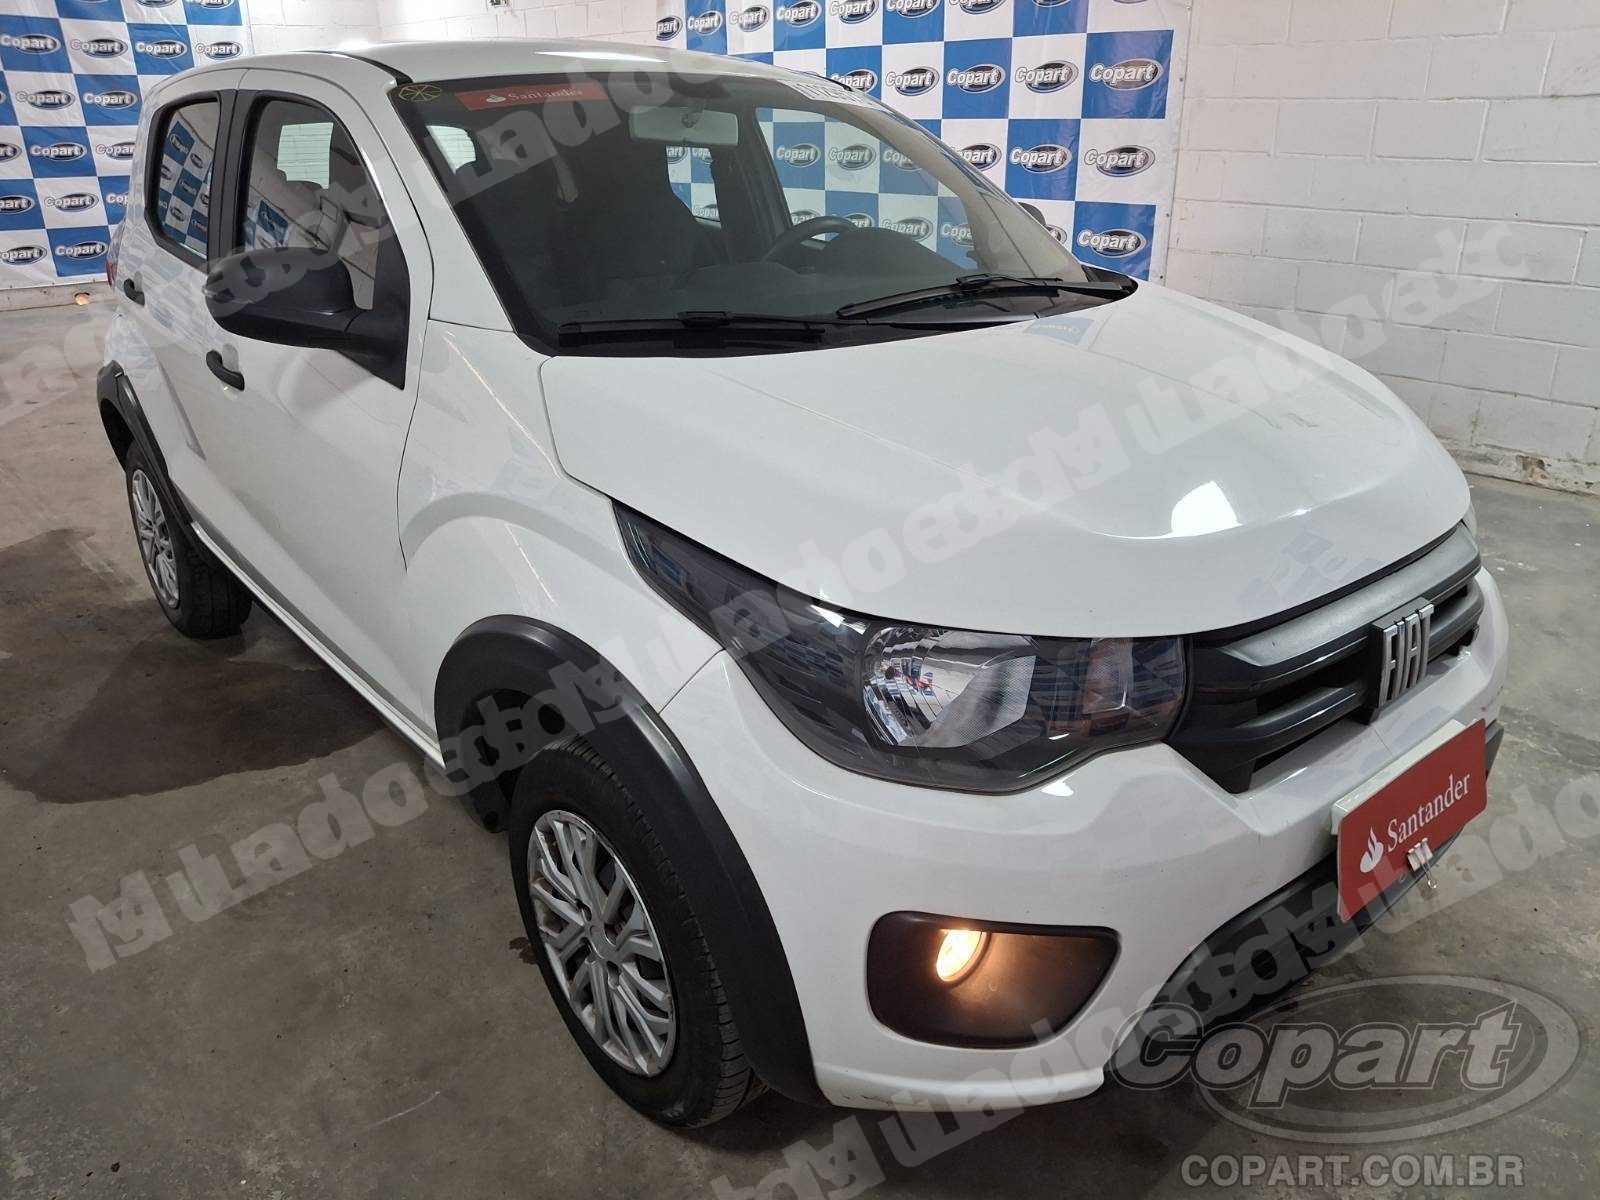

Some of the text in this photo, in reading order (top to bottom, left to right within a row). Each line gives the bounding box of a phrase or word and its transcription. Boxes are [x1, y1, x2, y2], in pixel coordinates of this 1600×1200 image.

[730, 10, 764, 27] Copart
[777, 5, 817, 21] Copart
[830, 1, 871, 19] Copart
[657, 20, 678, 34] part
[687, 14, 718, 32] Copart
[0, 35, 55, 50] Copart
[71, 38, 121, 55] Copart
[135, 41, 182, 54] Copart
[195, 42, 237, 55] Copart
[886, 71, 933, 89] Copart
[948, 65, 998, 87] Copart
[1014, 66, 1068, 88] Copart
[1091, 63, 1155, 86] Copart
[16, 91, 67, 105] Copart
[83, 93, 132, 106] Copart
[508, 88, 583, 101] Santander
[31, 145, 81, 157] Copart
[96, 144, 136, 157] Copar
[776, 146, 816, 163] Copart
[829, 146, 870, 163] Copart
[1010, 148, 1063, 166] Copart
[1084, 148, 1146, 168] Copart
[44, 195, 92, 208] Copart
[1078, 229, 1138, 250] Copart
[0, 249, 41, 263] opart
[56, 244, 102, 257] Copart
[1377, 602, 1434, 707] FIAT
[1386, 772, 1472, 853] Santander
